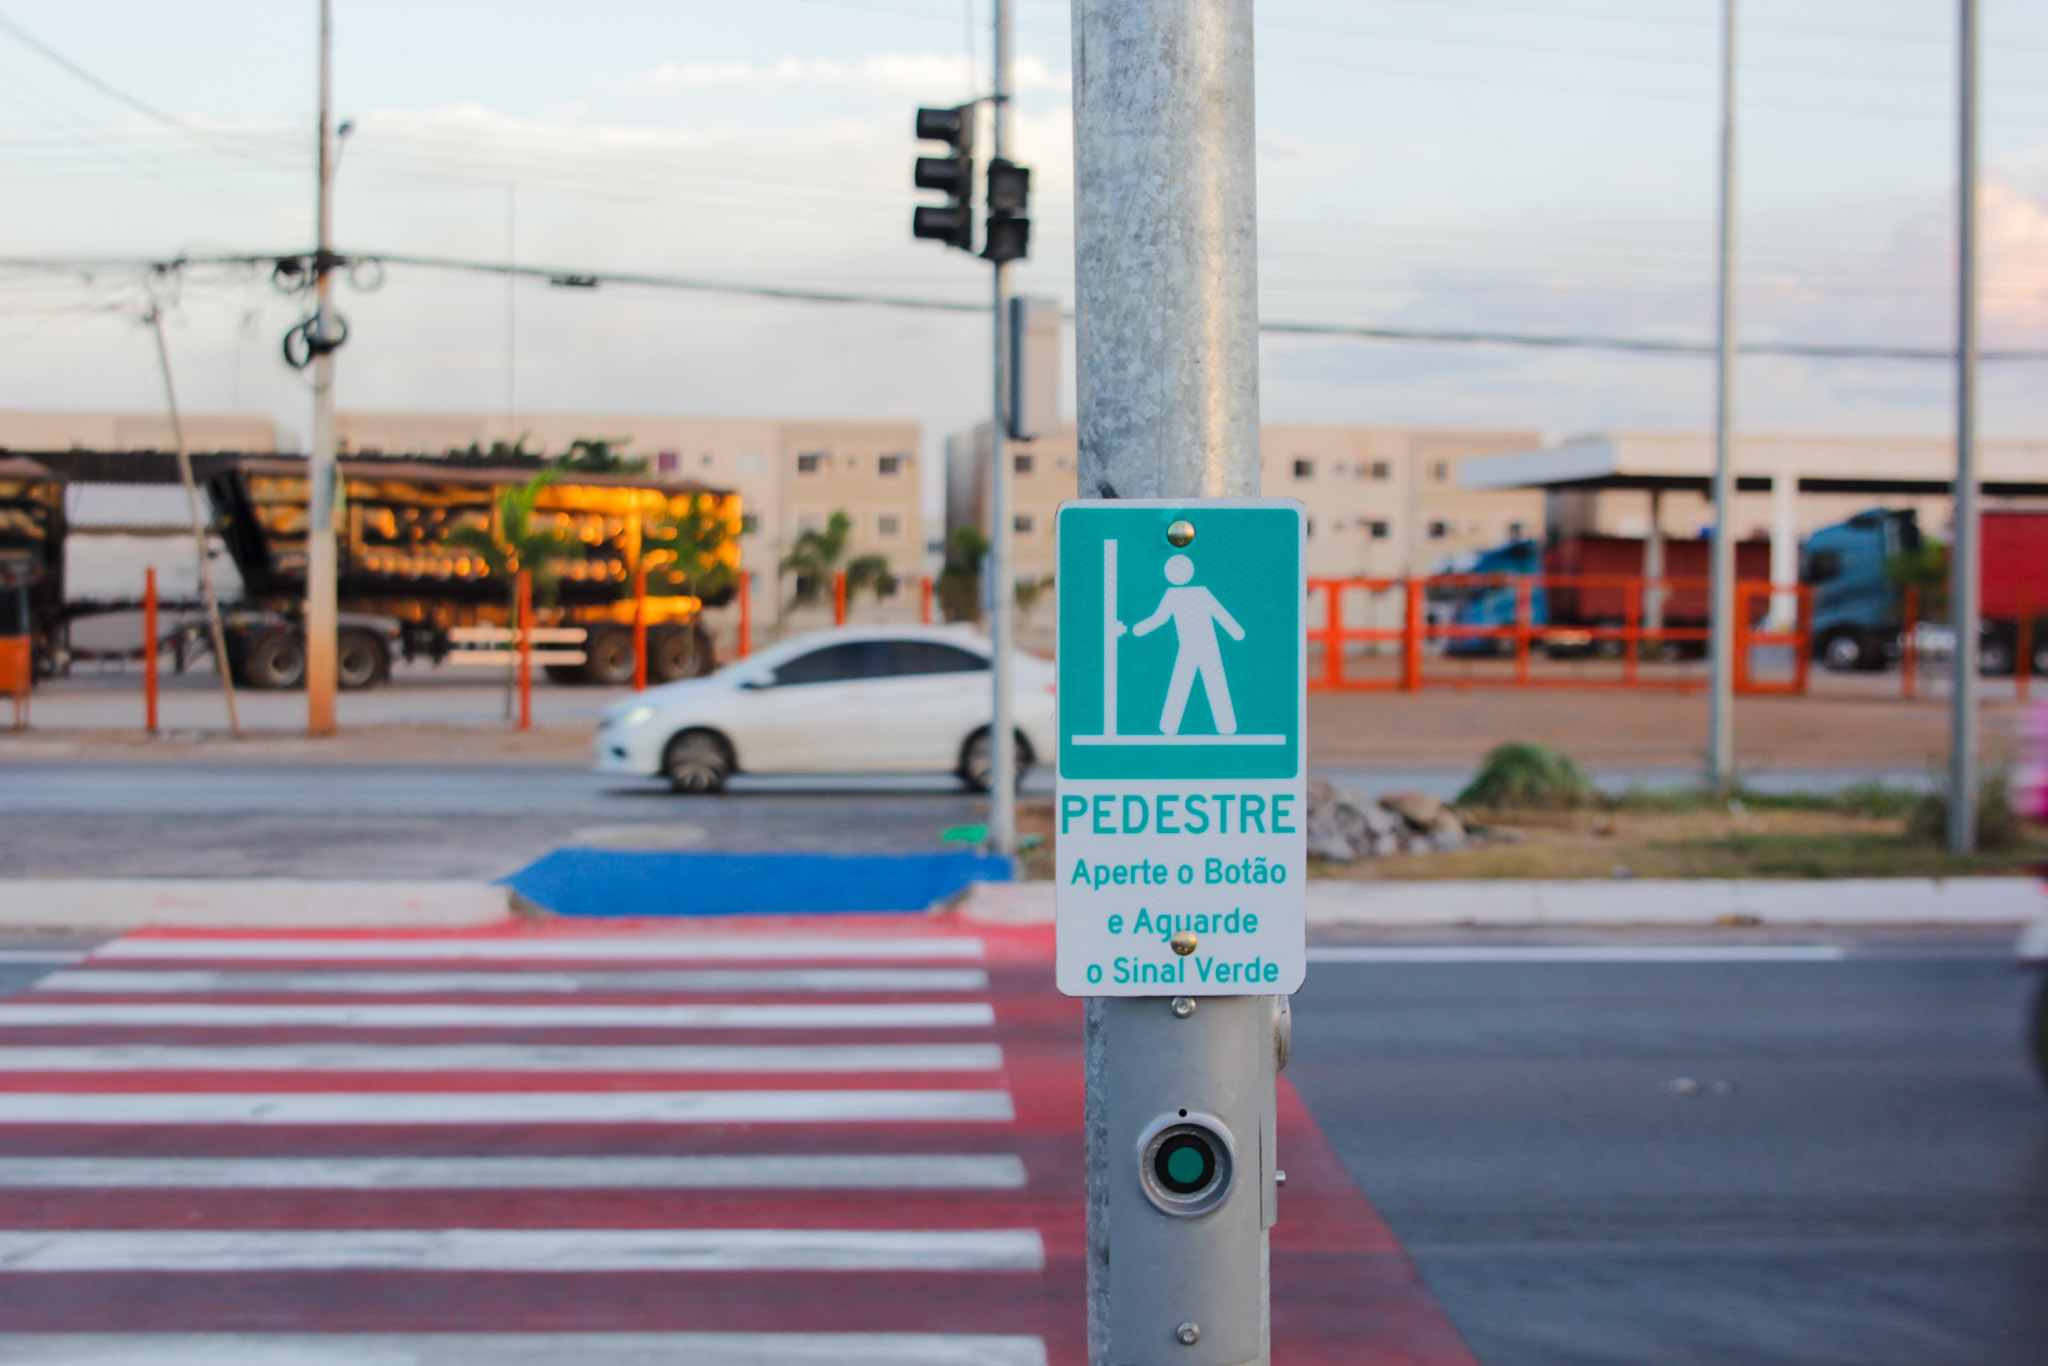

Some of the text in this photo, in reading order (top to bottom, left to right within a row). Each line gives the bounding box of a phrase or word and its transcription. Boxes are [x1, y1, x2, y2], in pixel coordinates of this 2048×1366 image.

[1061, 794, 1297, 835] PEDESTRE
[1070, 857, 1287, 891] Aperte o Botão
[1107, 907, 1259, 943] e Aguarde
[1086, 956, 1280, 984] o Sinal Verde
